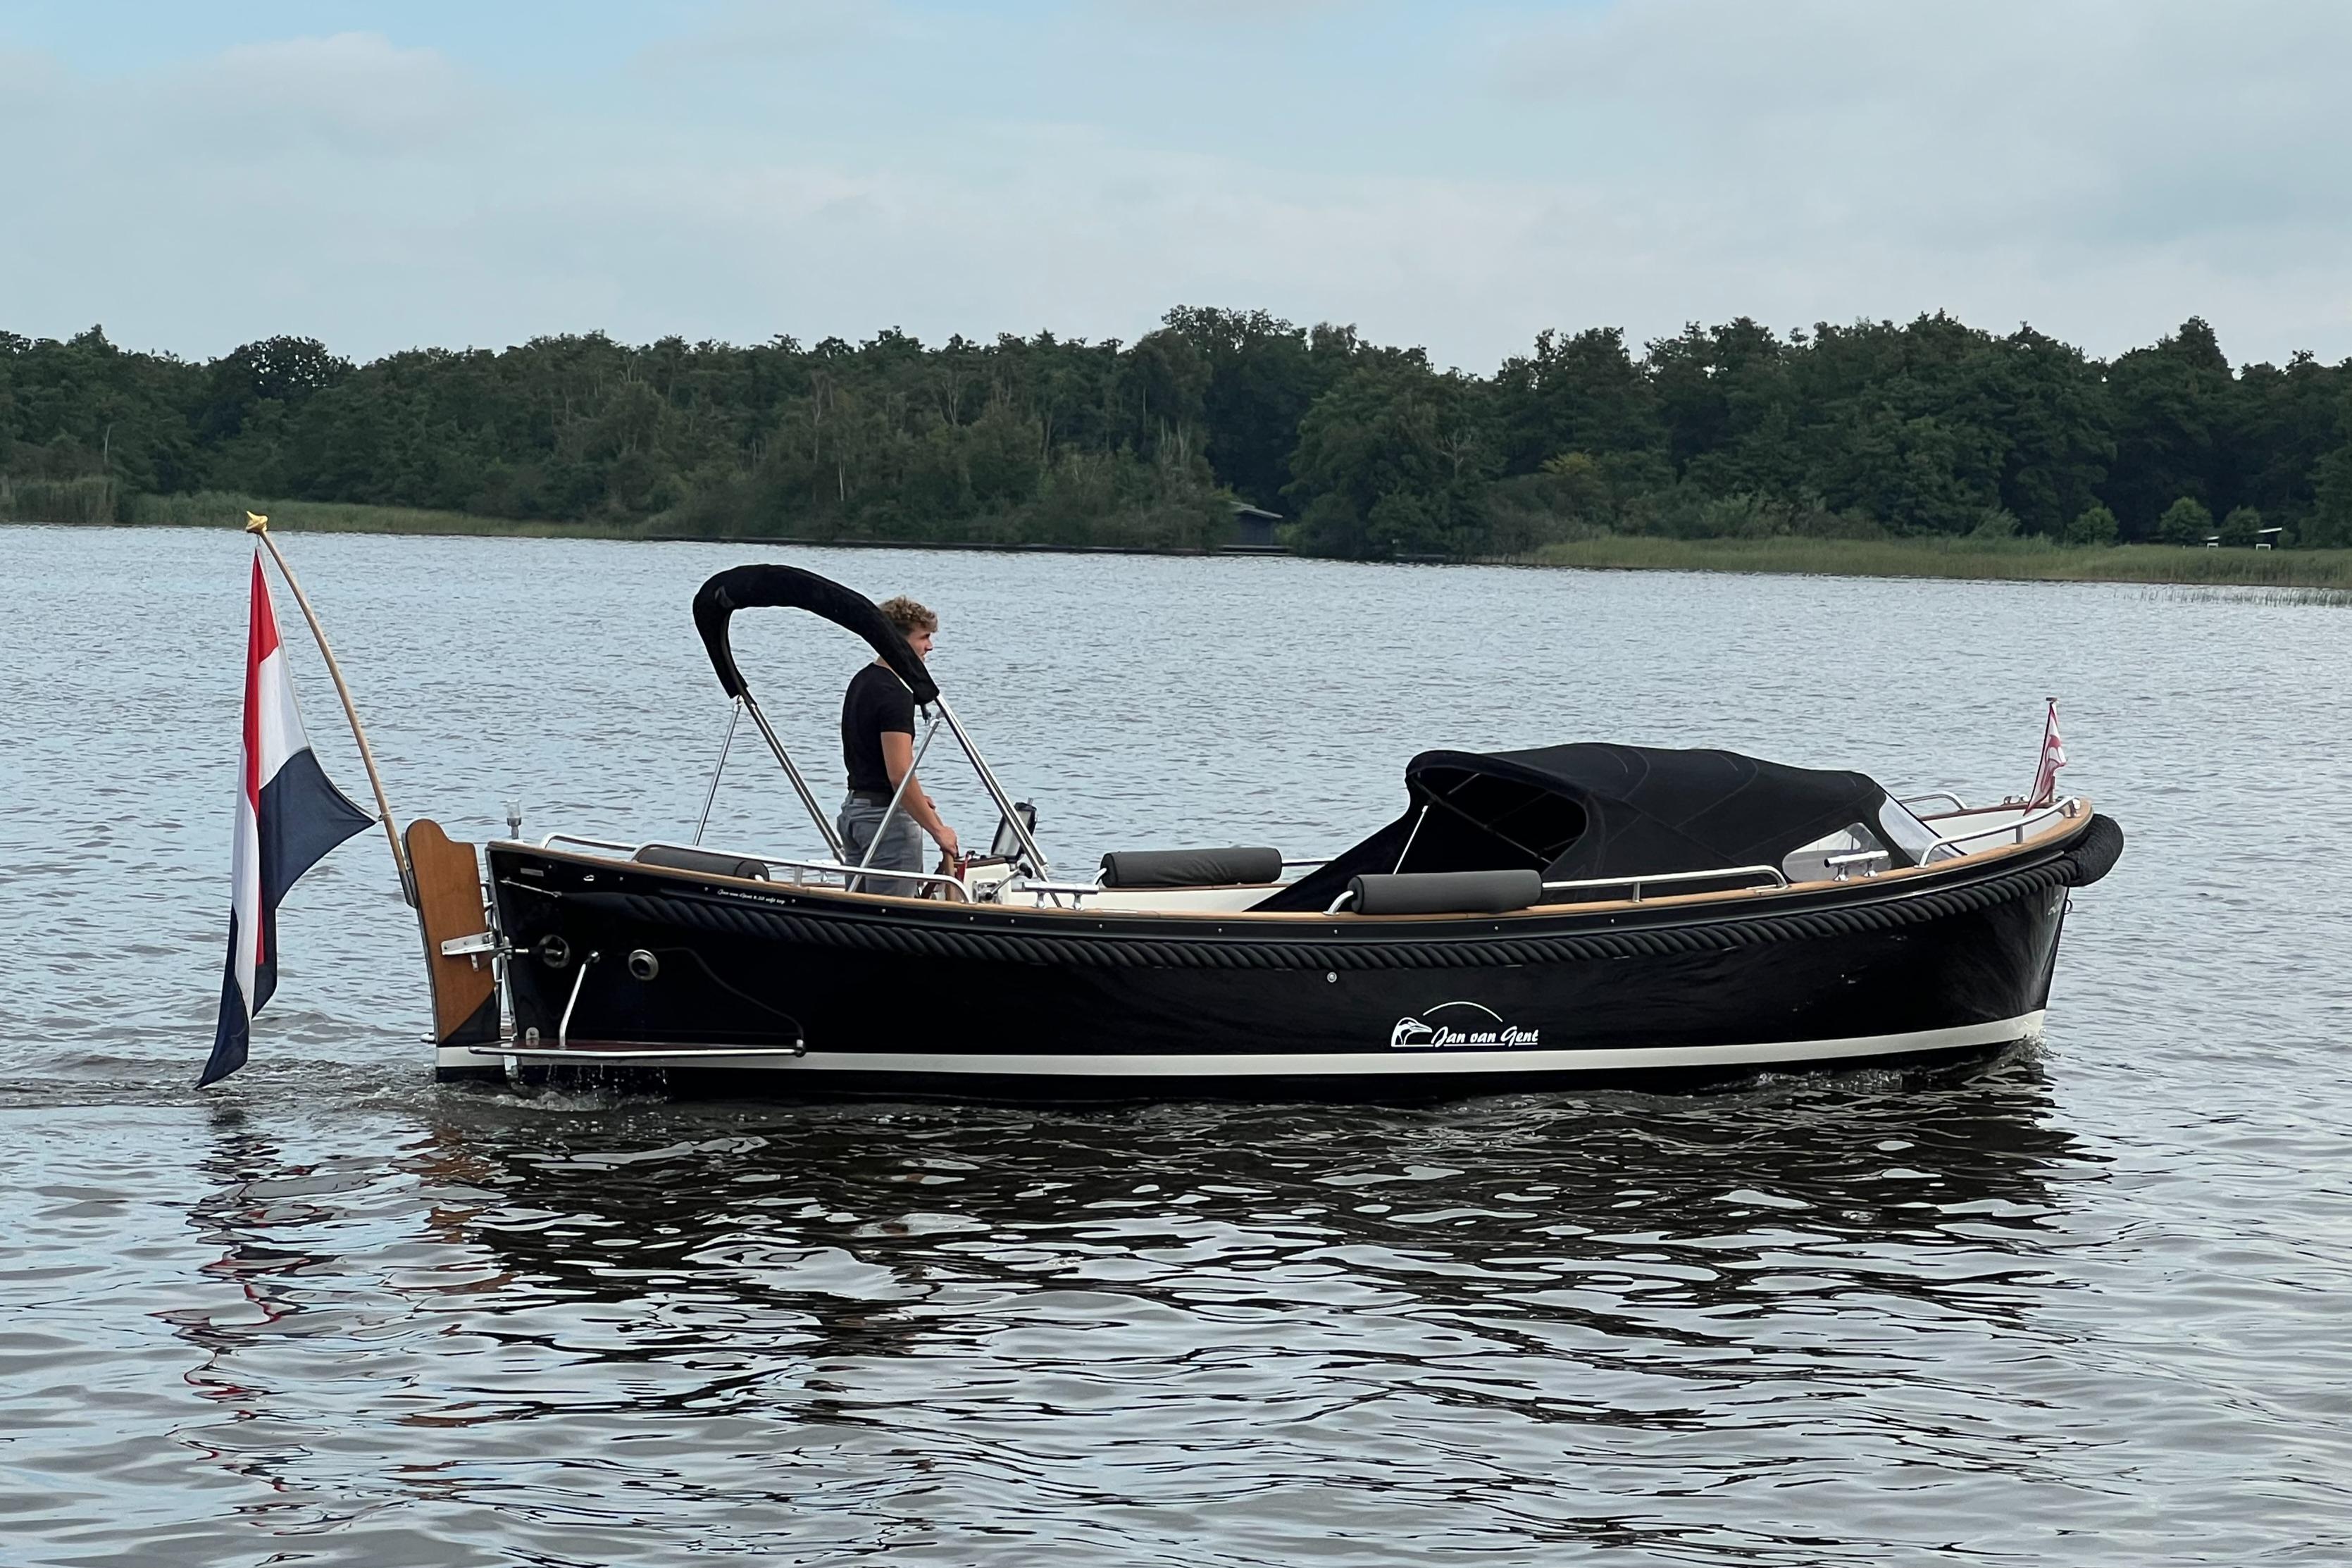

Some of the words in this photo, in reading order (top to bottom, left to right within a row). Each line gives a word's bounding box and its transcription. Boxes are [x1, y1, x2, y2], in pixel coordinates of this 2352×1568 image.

[1431, 1026, 1465, 1048] Jan
[1469, 1031, 1496, 1043] van
[1500, 1026, 1539, 1047] Gent
